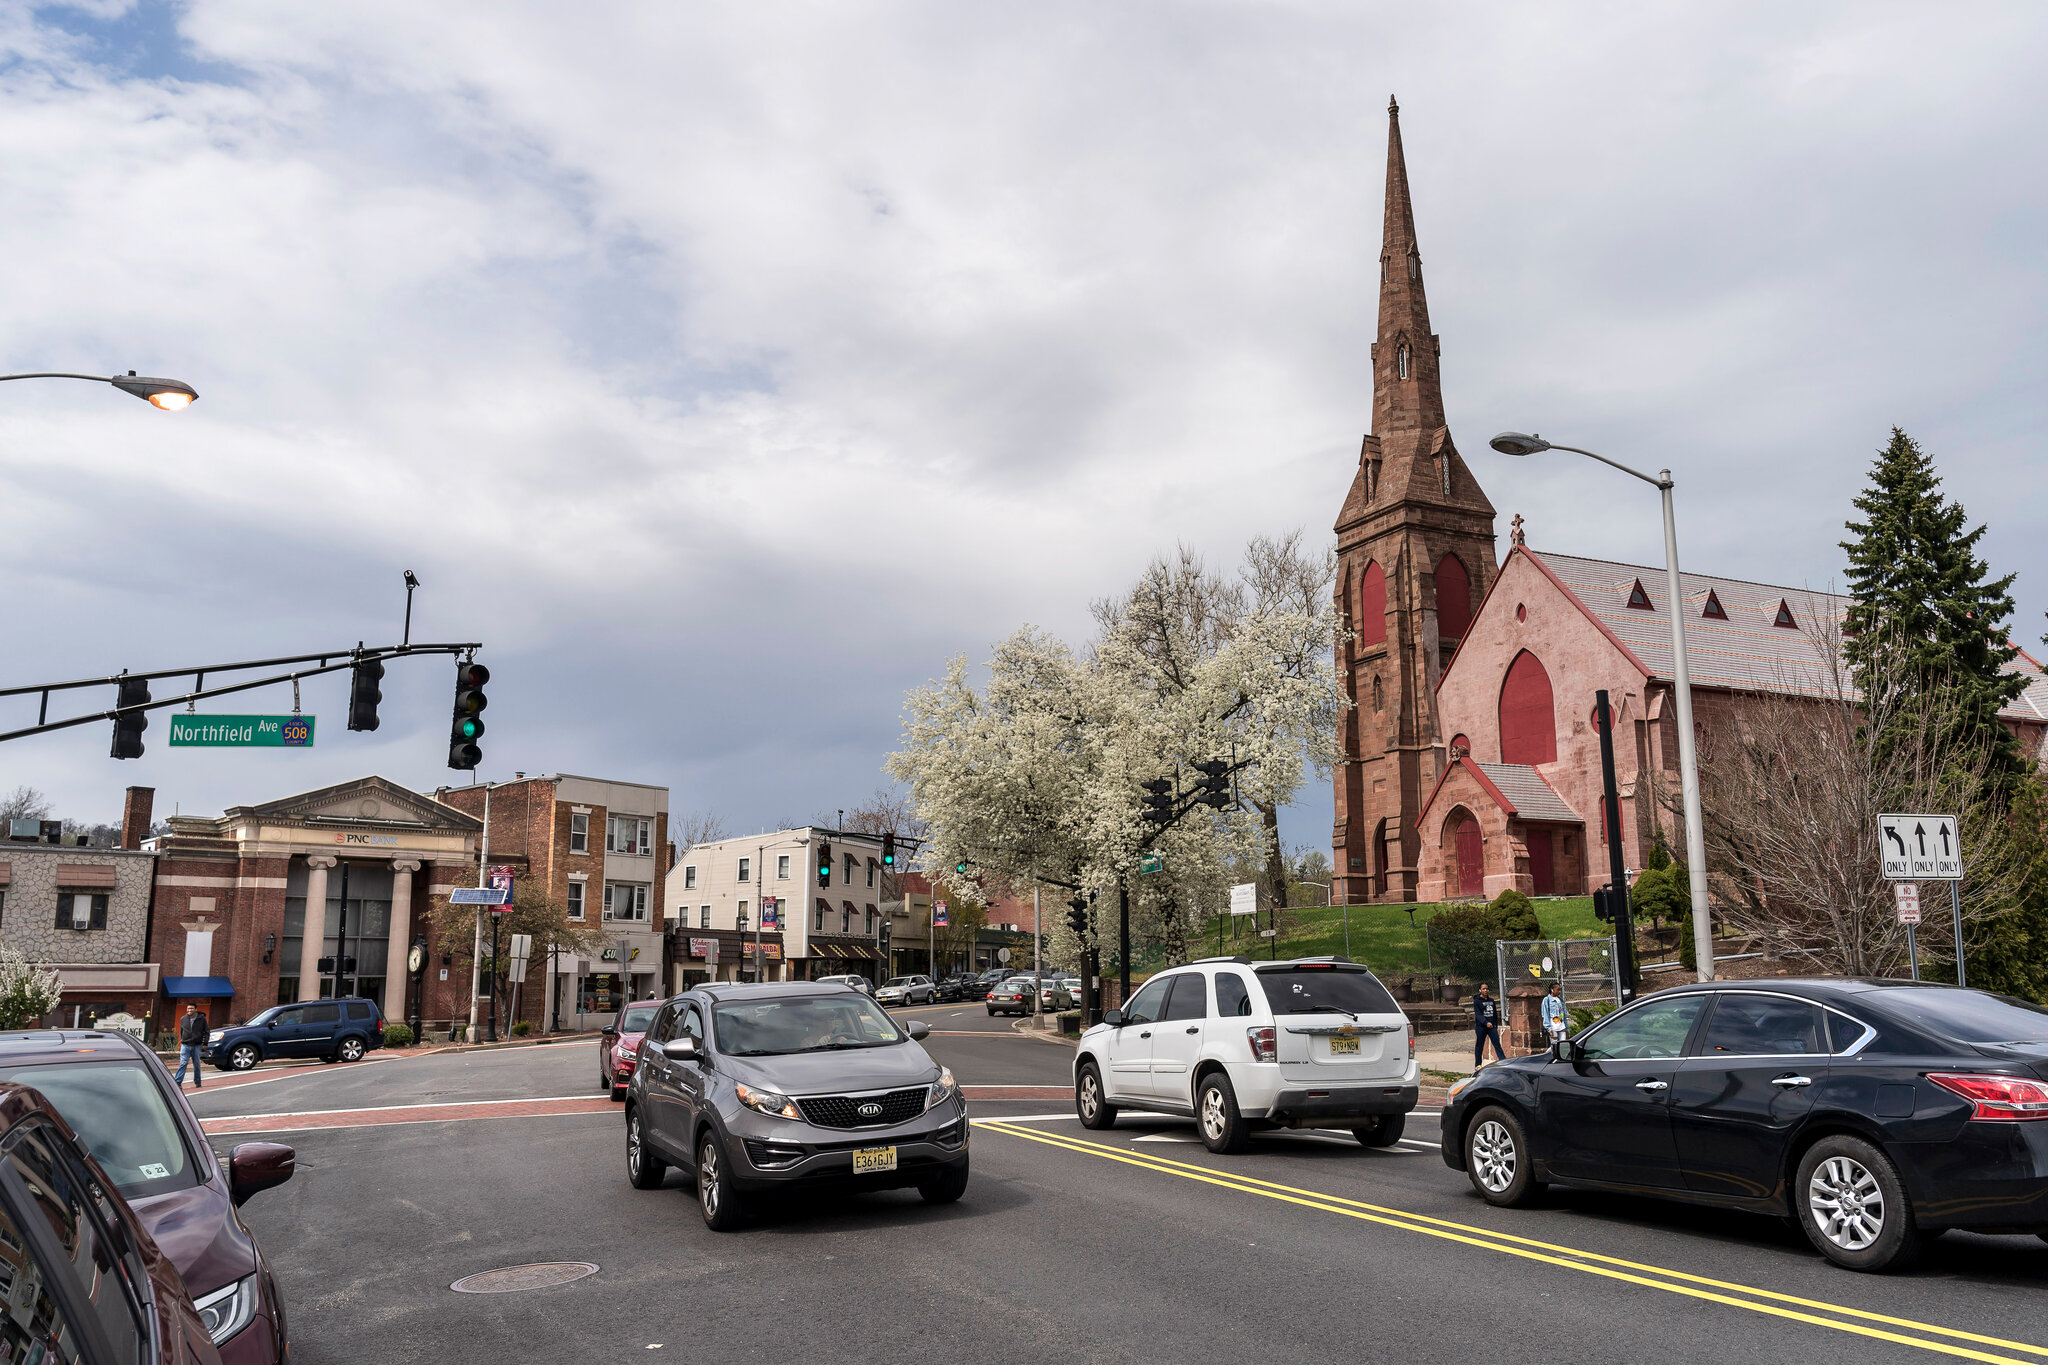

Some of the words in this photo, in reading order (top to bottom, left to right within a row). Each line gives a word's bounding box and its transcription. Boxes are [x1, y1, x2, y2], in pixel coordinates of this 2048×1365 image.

[173, 724, 252, 742] Northfield
[258, 720, 278, 732] Ave
[284, 726, 307, 739] 508
[346, 834, 369, 843] PNC
[1886, 861, 1907, 873] ONLY
[1914, 861, 1934, 872] ONLY
[1939, 861, 1958, 872] ONLY
[1903, 887, 1911, 895] NO
[604, 949, 639, 959] SUY
[862, 1106, 879, 1115] KIA
